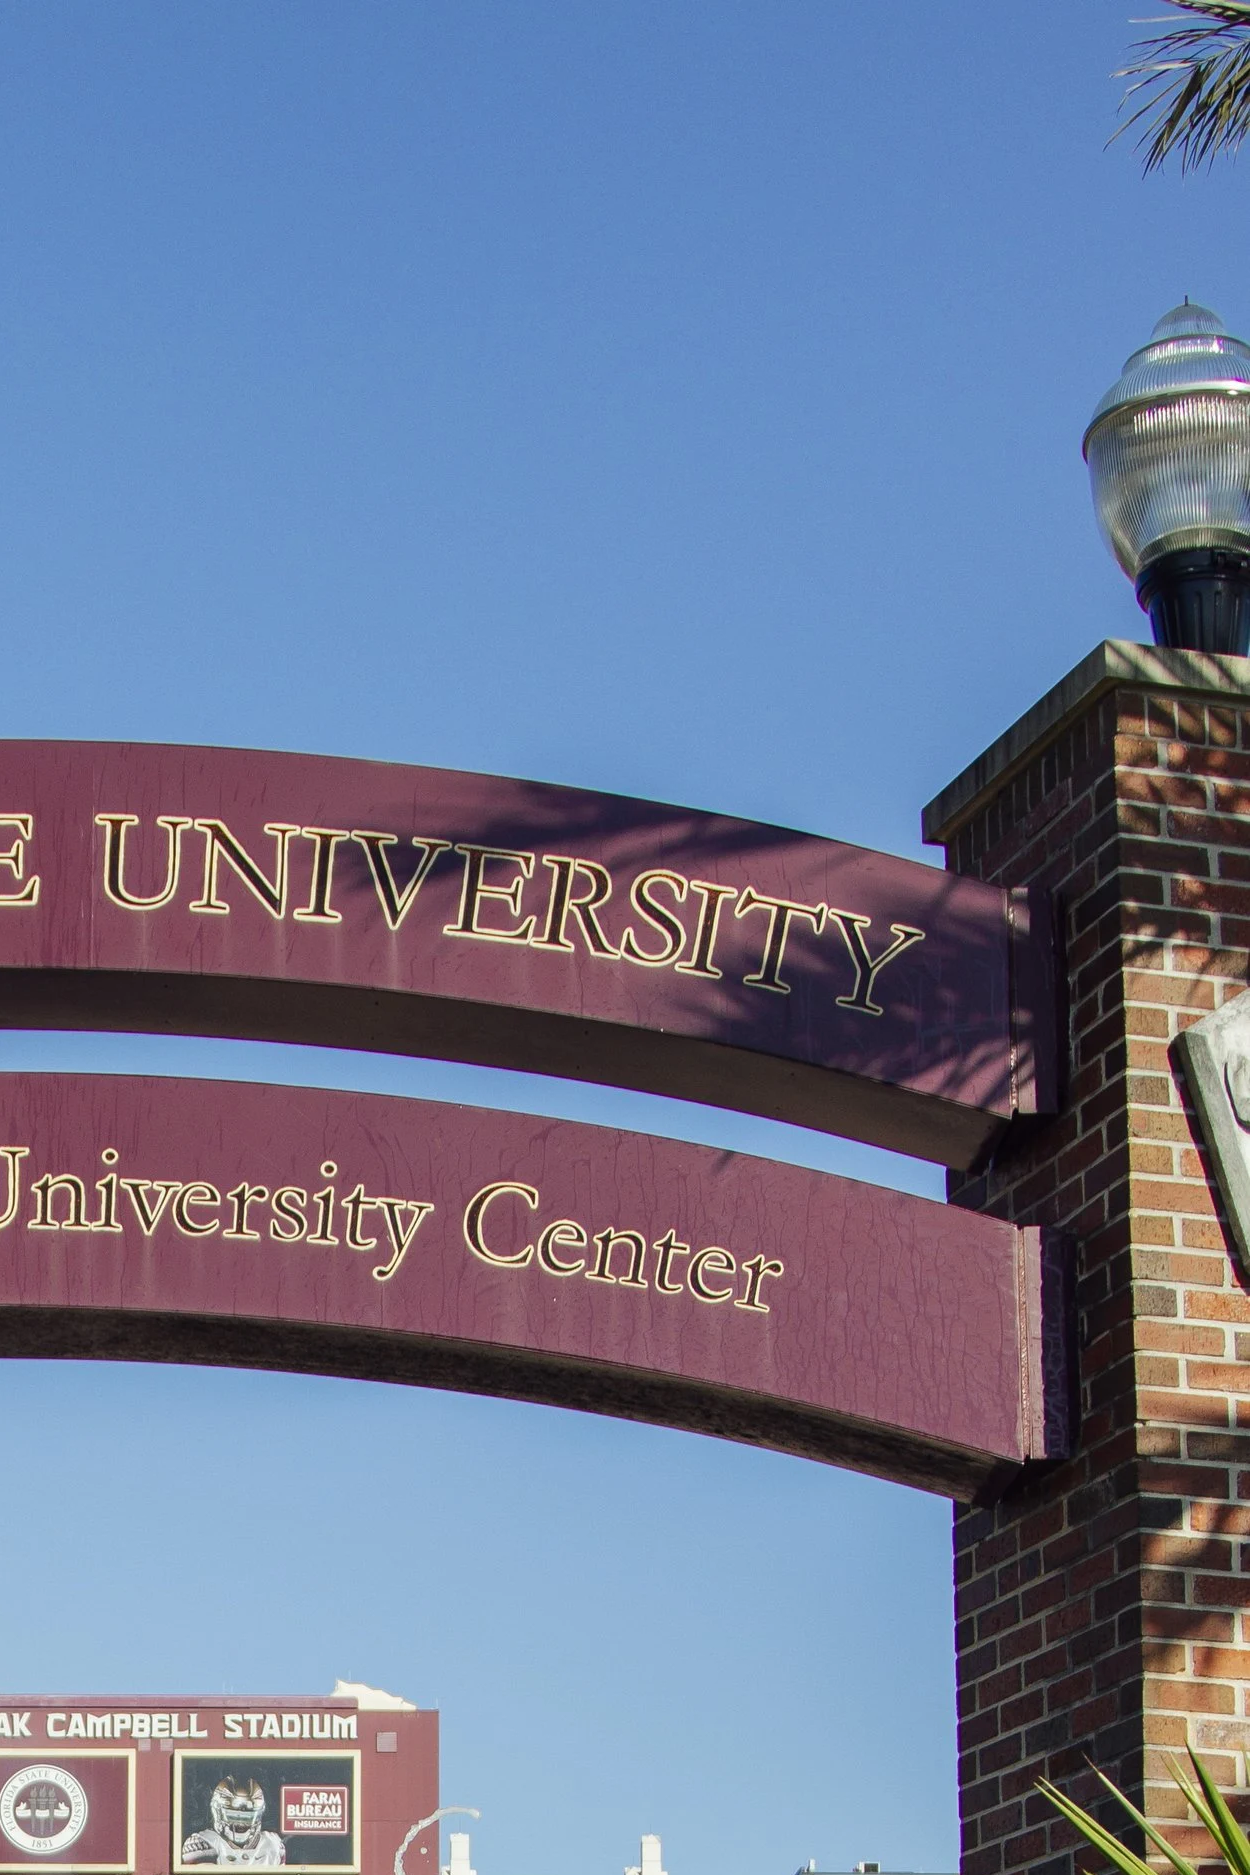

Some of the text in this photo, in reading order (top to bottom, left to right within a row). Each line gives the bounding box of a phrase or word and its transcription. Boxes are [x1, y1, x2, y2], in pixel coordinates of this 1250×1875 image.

[95, 813, 925, 1016] UNIVERSITY
[463, 1180, 785, 1314] Center
[46, 1713, 208, 1739] CAMPBELL
[223, 1713, 359, 1739] STADIUM
[3, 1769, 83, 1833] FLORIDA STATE UNIVERSITY
[302, 1791, 342, 1805] FARM
[286, 1804, 342, 1817] BUREAU
[294, 1820, 342, 1829] INSURANCE
[31, 1839, 53, 1848] 1851
